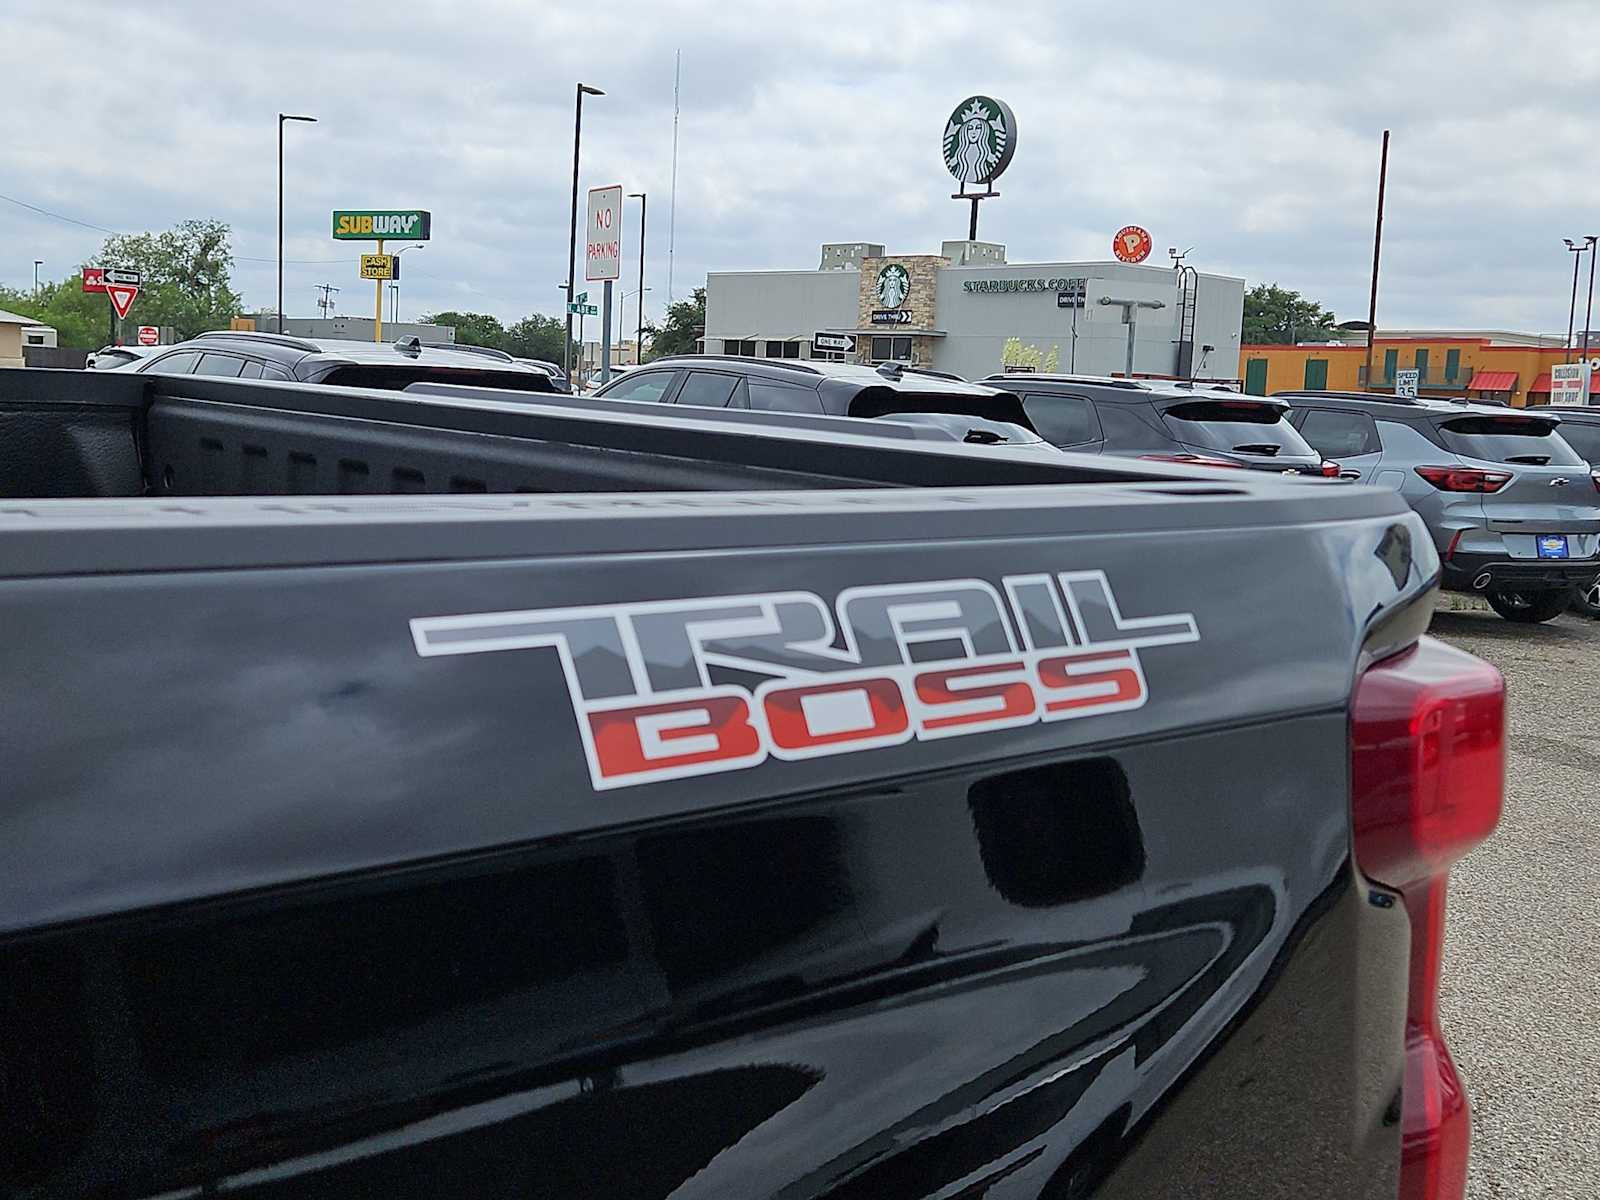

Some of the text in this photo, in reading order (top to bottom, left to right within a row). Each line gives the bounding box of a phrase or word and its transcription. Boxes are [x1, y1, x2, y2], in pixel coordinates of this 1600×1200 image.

[336, 215, 419, 234] SUBWAY
[596, 208, 612, 229] NO
[588, 241, 618, 260] PARKING
[365, 257, 387, 266] CASH
[362, 267, 390, 276] STORE
[963, 278, 1087, 293] STARBUCKS COFF
[1399, 387, 1415, 397] 35
[409, 569, 1200, 706] TRAIL
[582, 648, 1149, 792] BOSS
